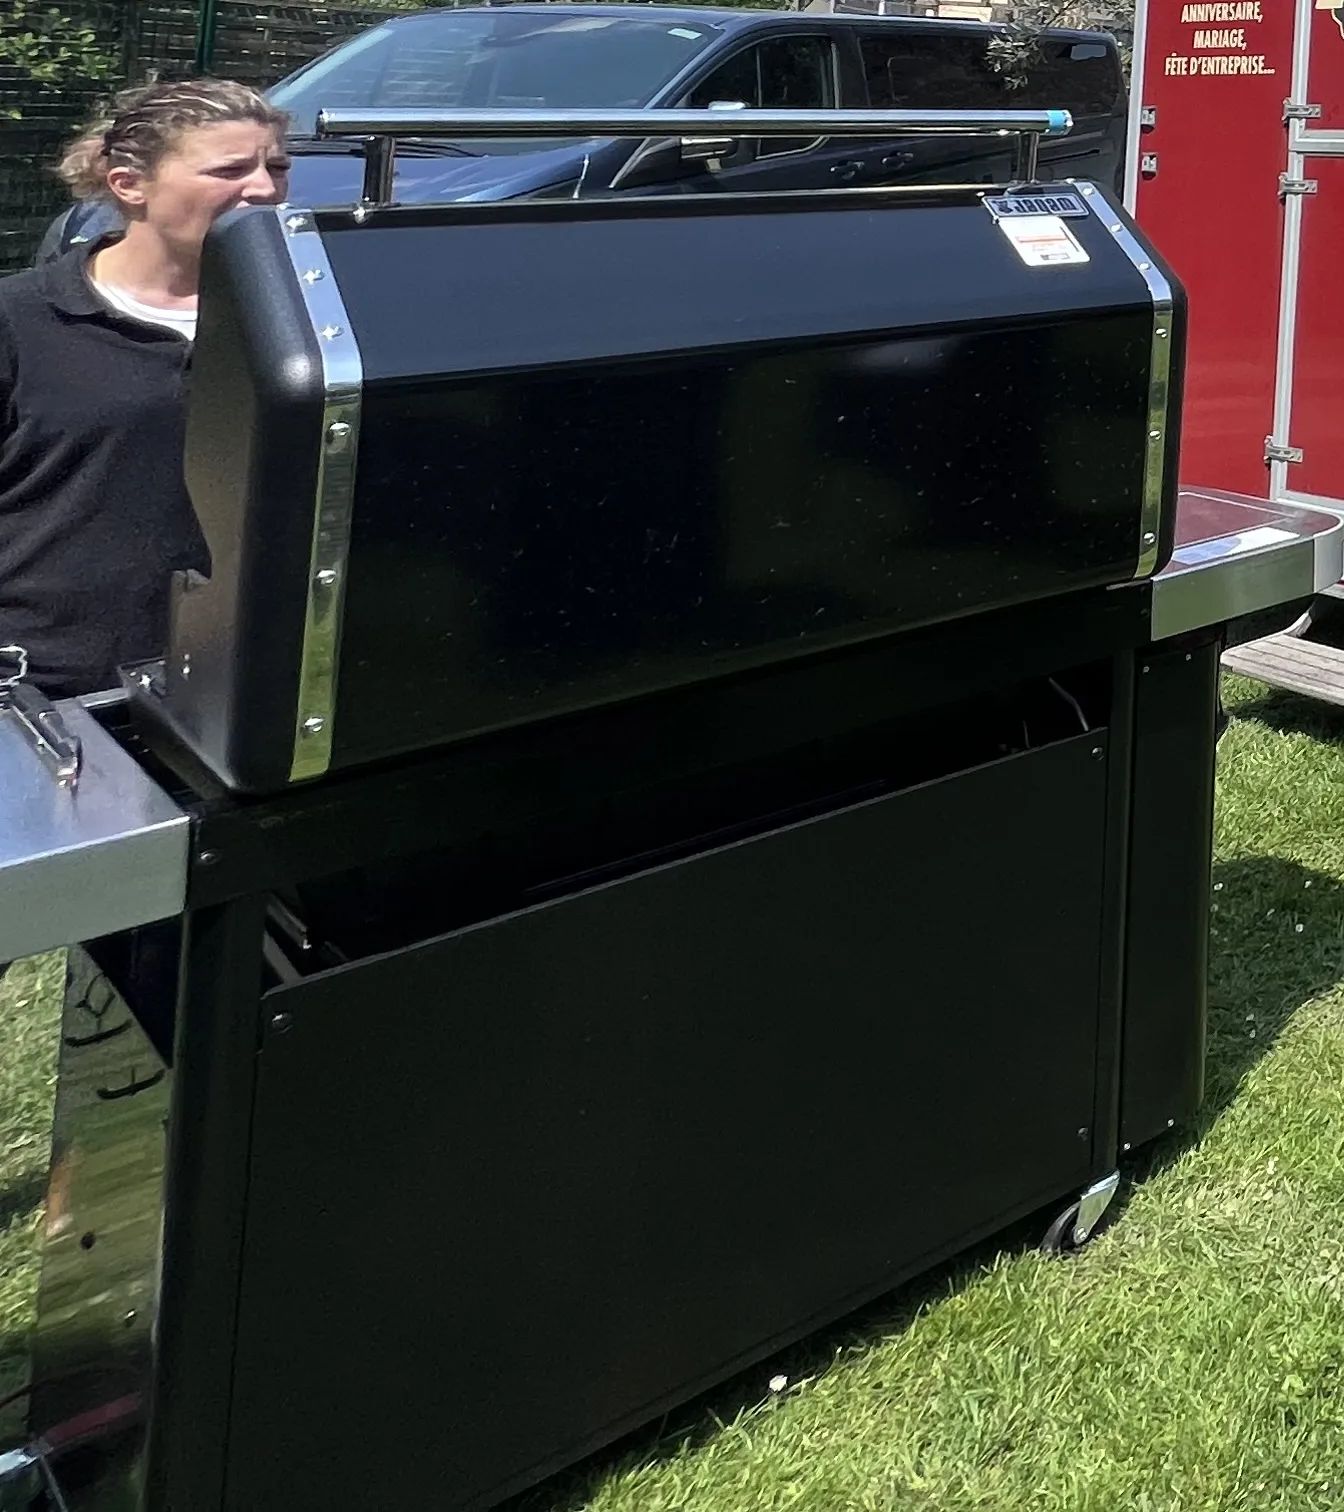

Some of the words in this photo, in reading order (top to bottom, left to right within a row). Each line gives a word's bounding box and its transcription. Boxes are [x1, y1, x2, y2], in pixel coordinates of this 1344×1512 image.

[1180, 1, 1264, 23] ANNIVERSAIRE,
[1193, 29, 1247, 50] MARIAGE,
[1165, 52, 1188, 75] FÊTE
[1189, 55, 1276, 76] D'ENTREPRISE...
